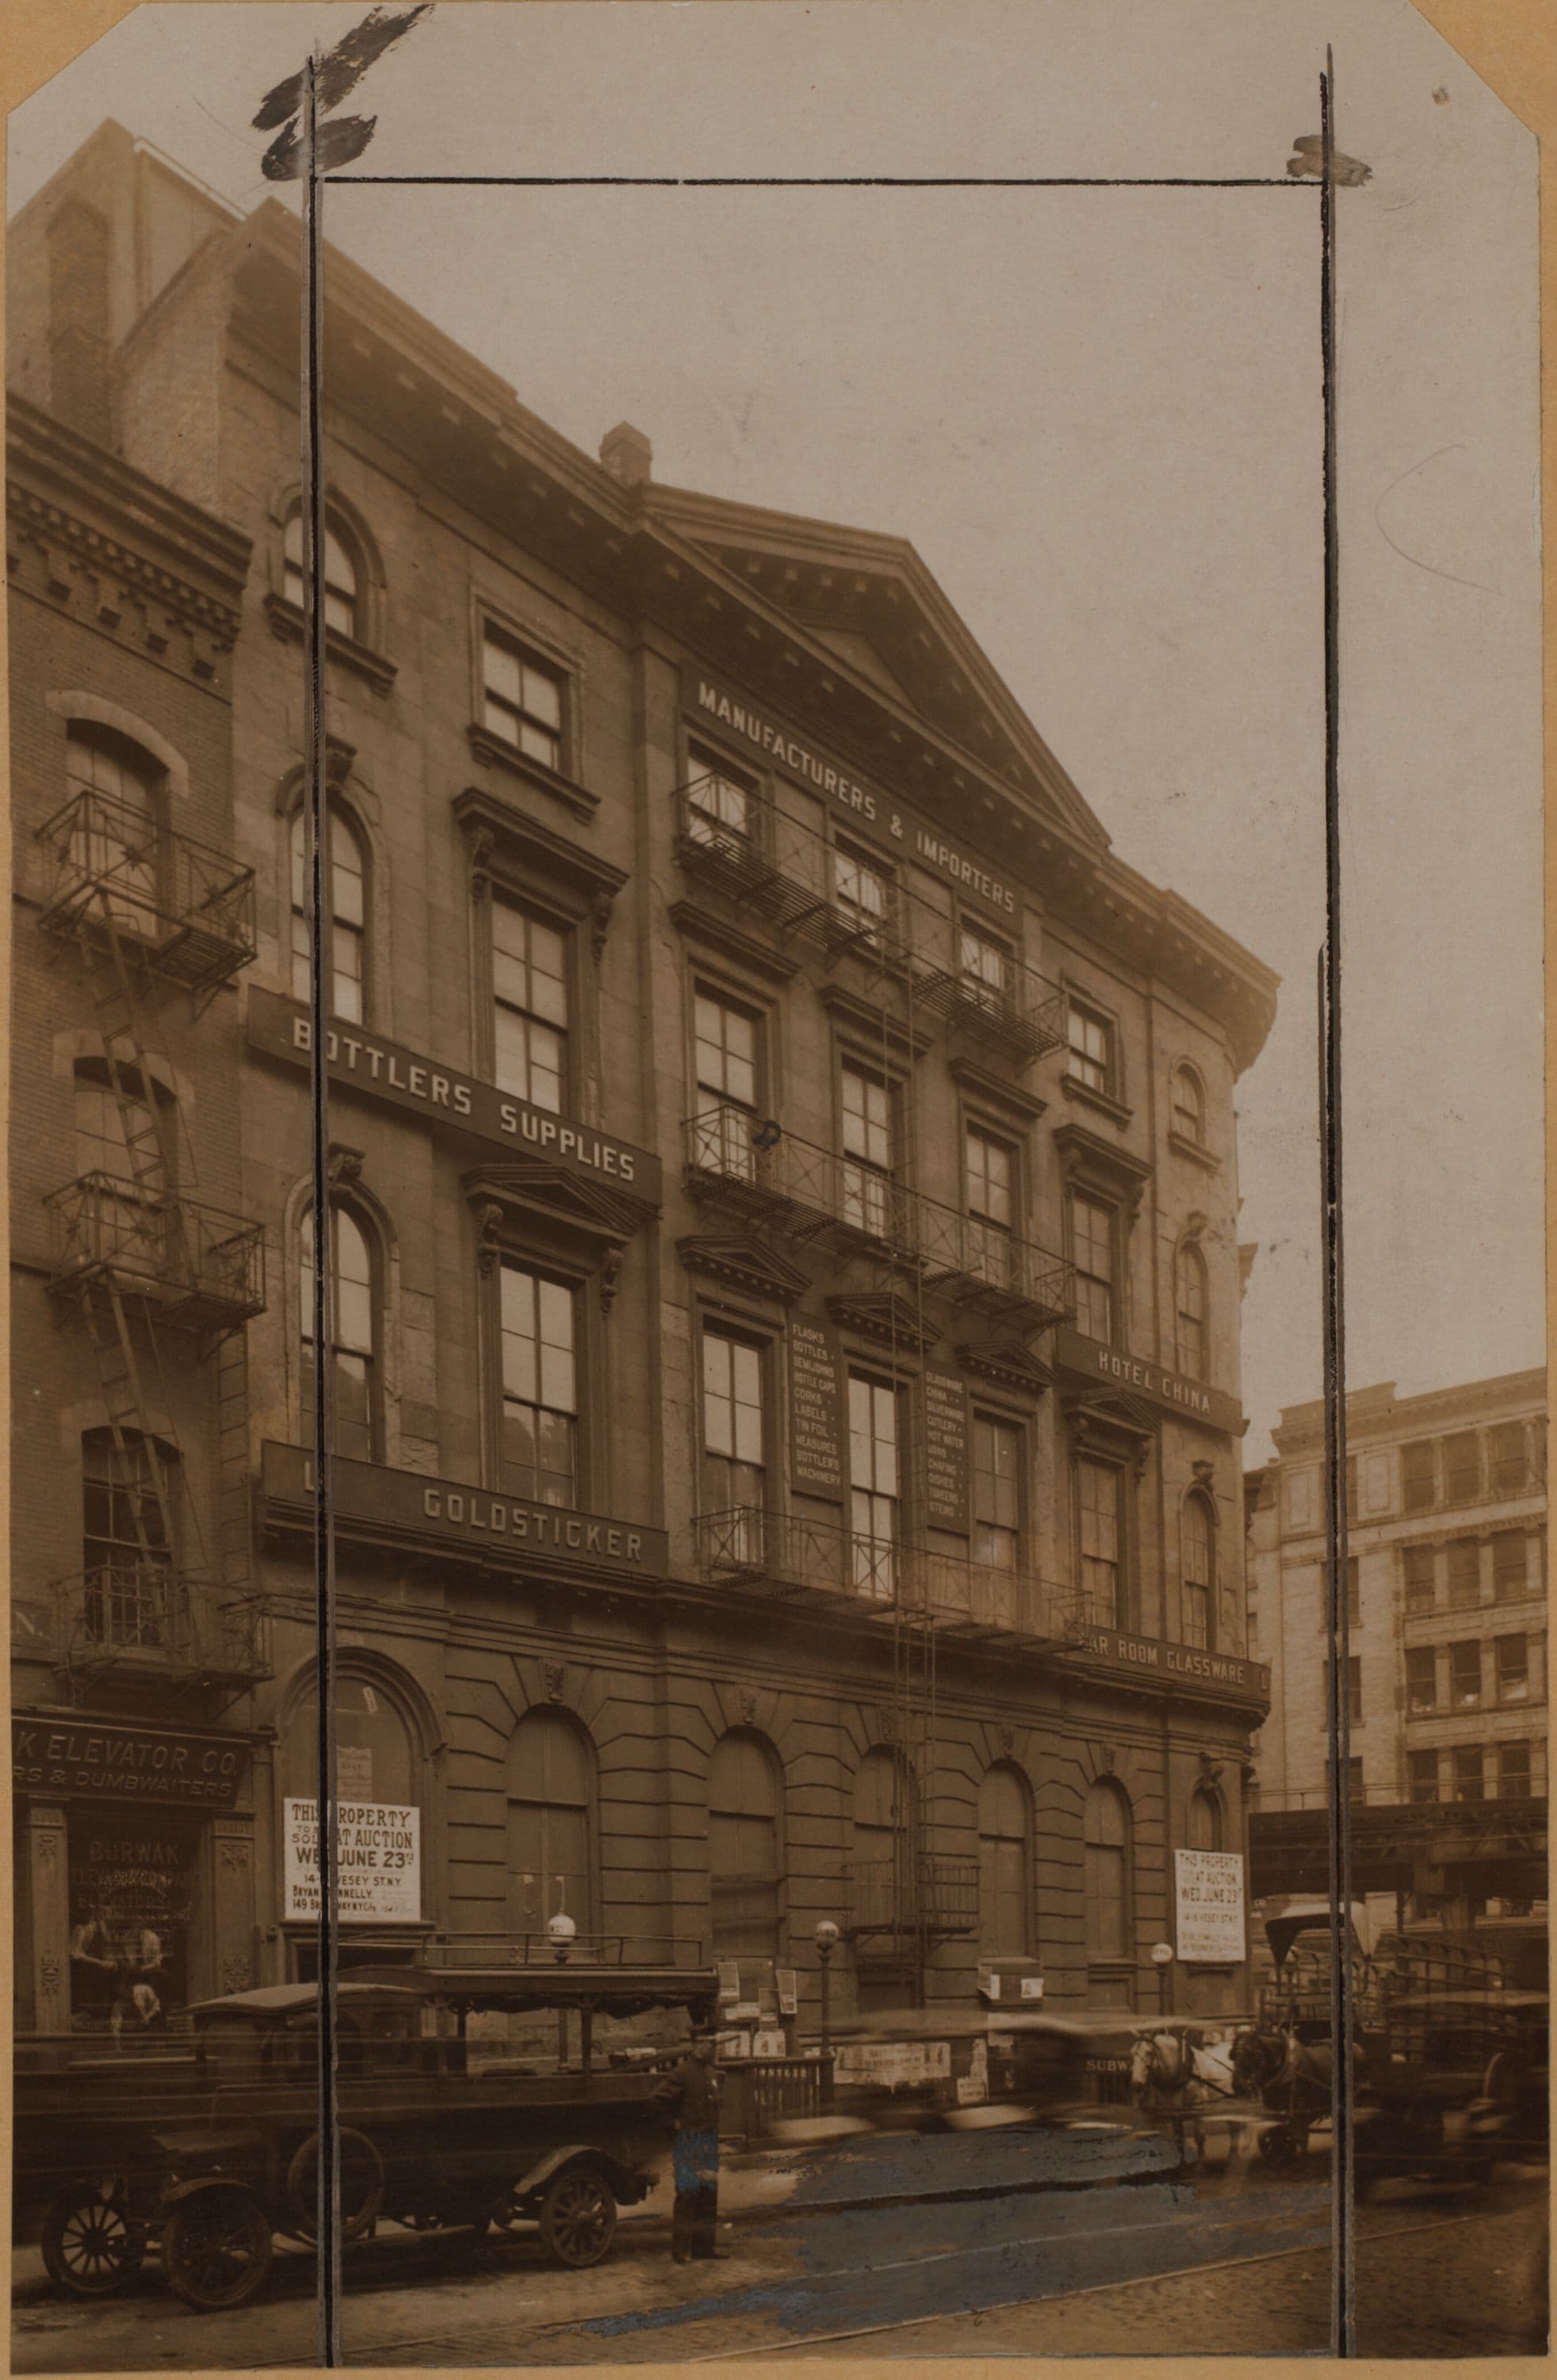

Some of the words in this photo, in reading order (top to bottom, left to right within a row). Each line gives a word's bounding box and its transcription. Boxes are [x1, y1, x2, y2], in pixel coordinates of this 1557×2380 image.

[698, 681, 876, 821] MANUFACTURERS
[889, 813, 904, 840] &
[916, 830, 1015, 914] IMPORTERS
[499, 1104, 635, 1182] SUPPLIES
[793, 1324, 824, 1345] FLASKS
[793, 1339, 828, 1360] BOTTLES
[794, 1371, 817, 1388] BOTTLE
[819, 1380, 836, 1395] CAPS
[926, 1372, 964, 1394] GLASSWARE
[1099, 1350, 1153, 1390] HOTEL
[1162, 1378, 1211, 1414] CHINA
[794, 1387, 822, 1405] CORKS
[794, 1402, 827, 1421] LABELS
[796, 1418, 809, 1432] TIN
[812, 1424, 829, 1438] FOIL
[796, 1433, 837, 1455] MEASURES
[797, 1465, 841, 1486] MACHINERY
[423, 1488, 641, 1561] GOLDSTICKER
[1118, 1639, 1158, 1666] ROOM
[1167, 1651, 1245, 1686] GLASSWARE
[47, 1734, 189, 1771] ELEVATOR
[201, 1750, 237, 1775] CO.
[49, 1769, 67, 1785] &
[75, 1770, 232, 1796] DUMBWAITERS
[339, 1807, 411, 1828] ROPERTY
[291, 1833, 320, 1845] SOL
[354, 1829, 413, 1850] AUCTION
[90, 1839, 179, 1865] BURWAK
[336, 1849, 377, 1867] JUNE
[293, 1899, 308, 1910] 149
